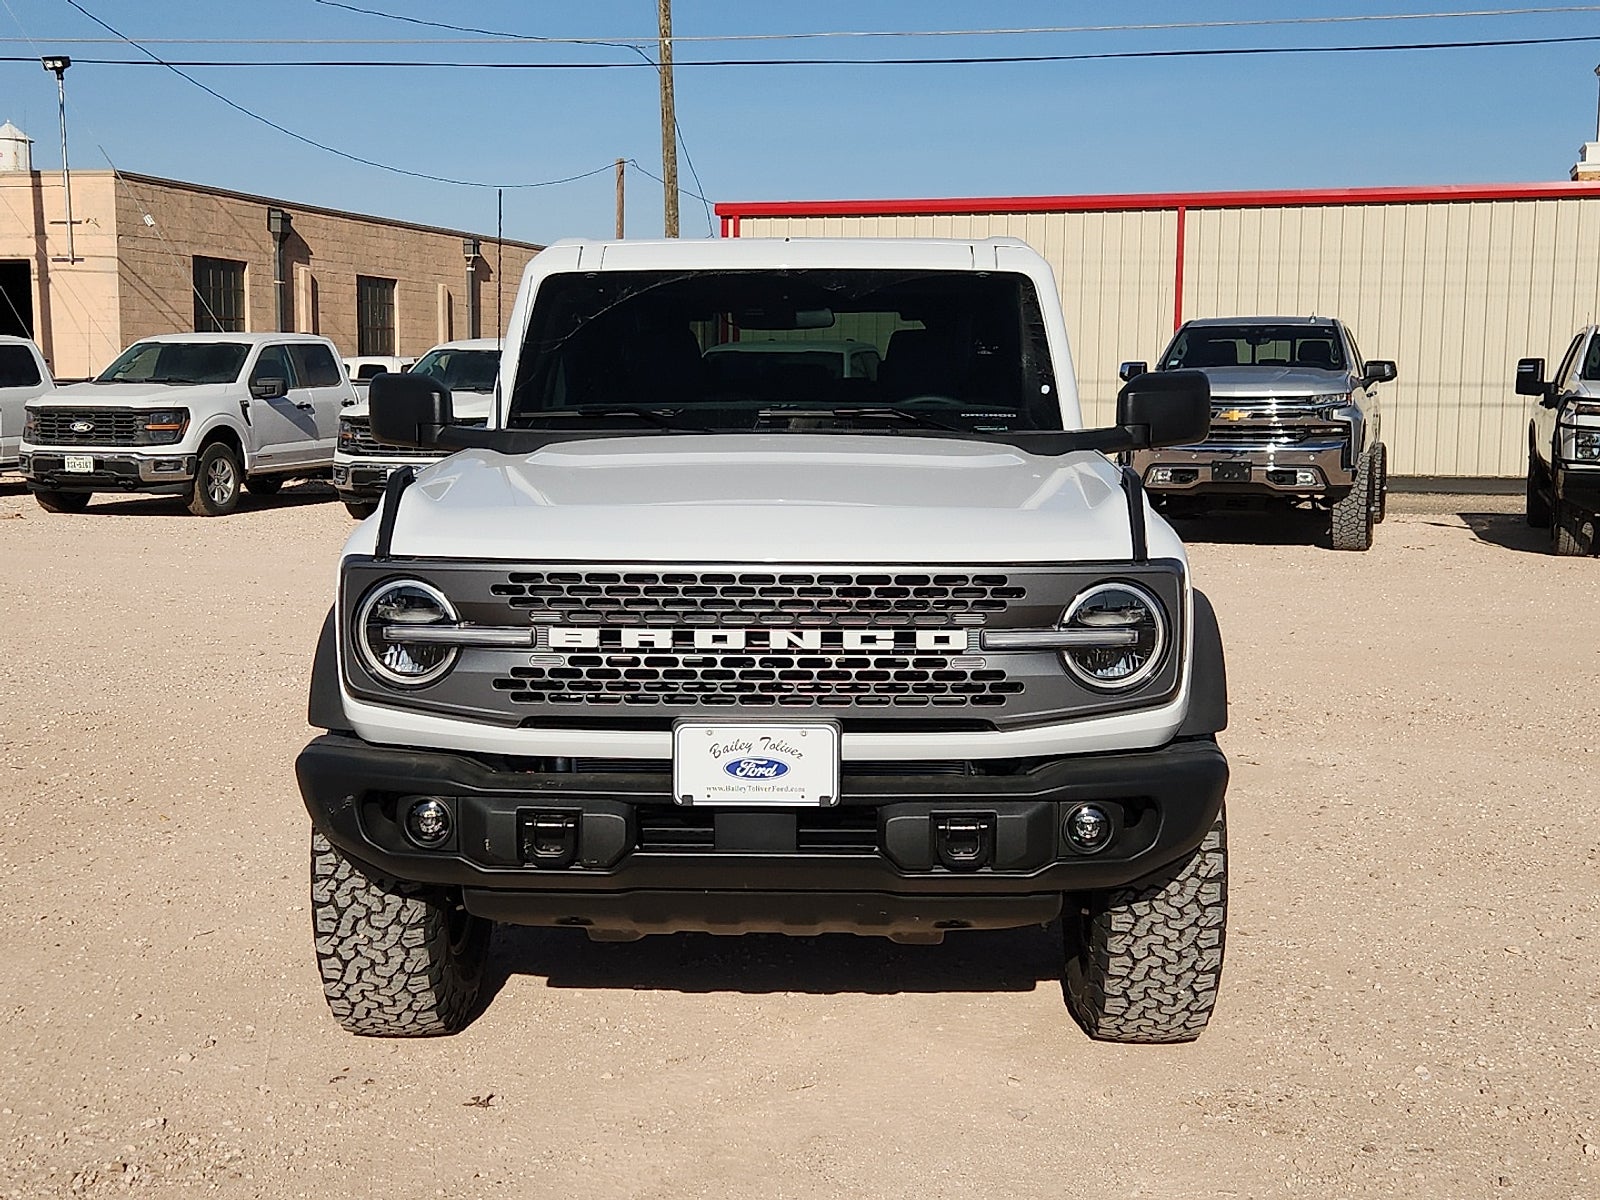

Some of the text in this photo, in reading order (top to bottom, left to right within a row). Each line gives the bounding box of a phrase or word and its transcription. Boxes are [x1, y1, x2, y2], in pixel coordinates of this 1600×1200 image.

[548, 627, 969, 650] BRONCO
[709, 736, 804, 760] Bailey Toliver
[735, 758, 777, 778] Ford
[706, 785, 806, 794] www.BaileyToliverFord.com
